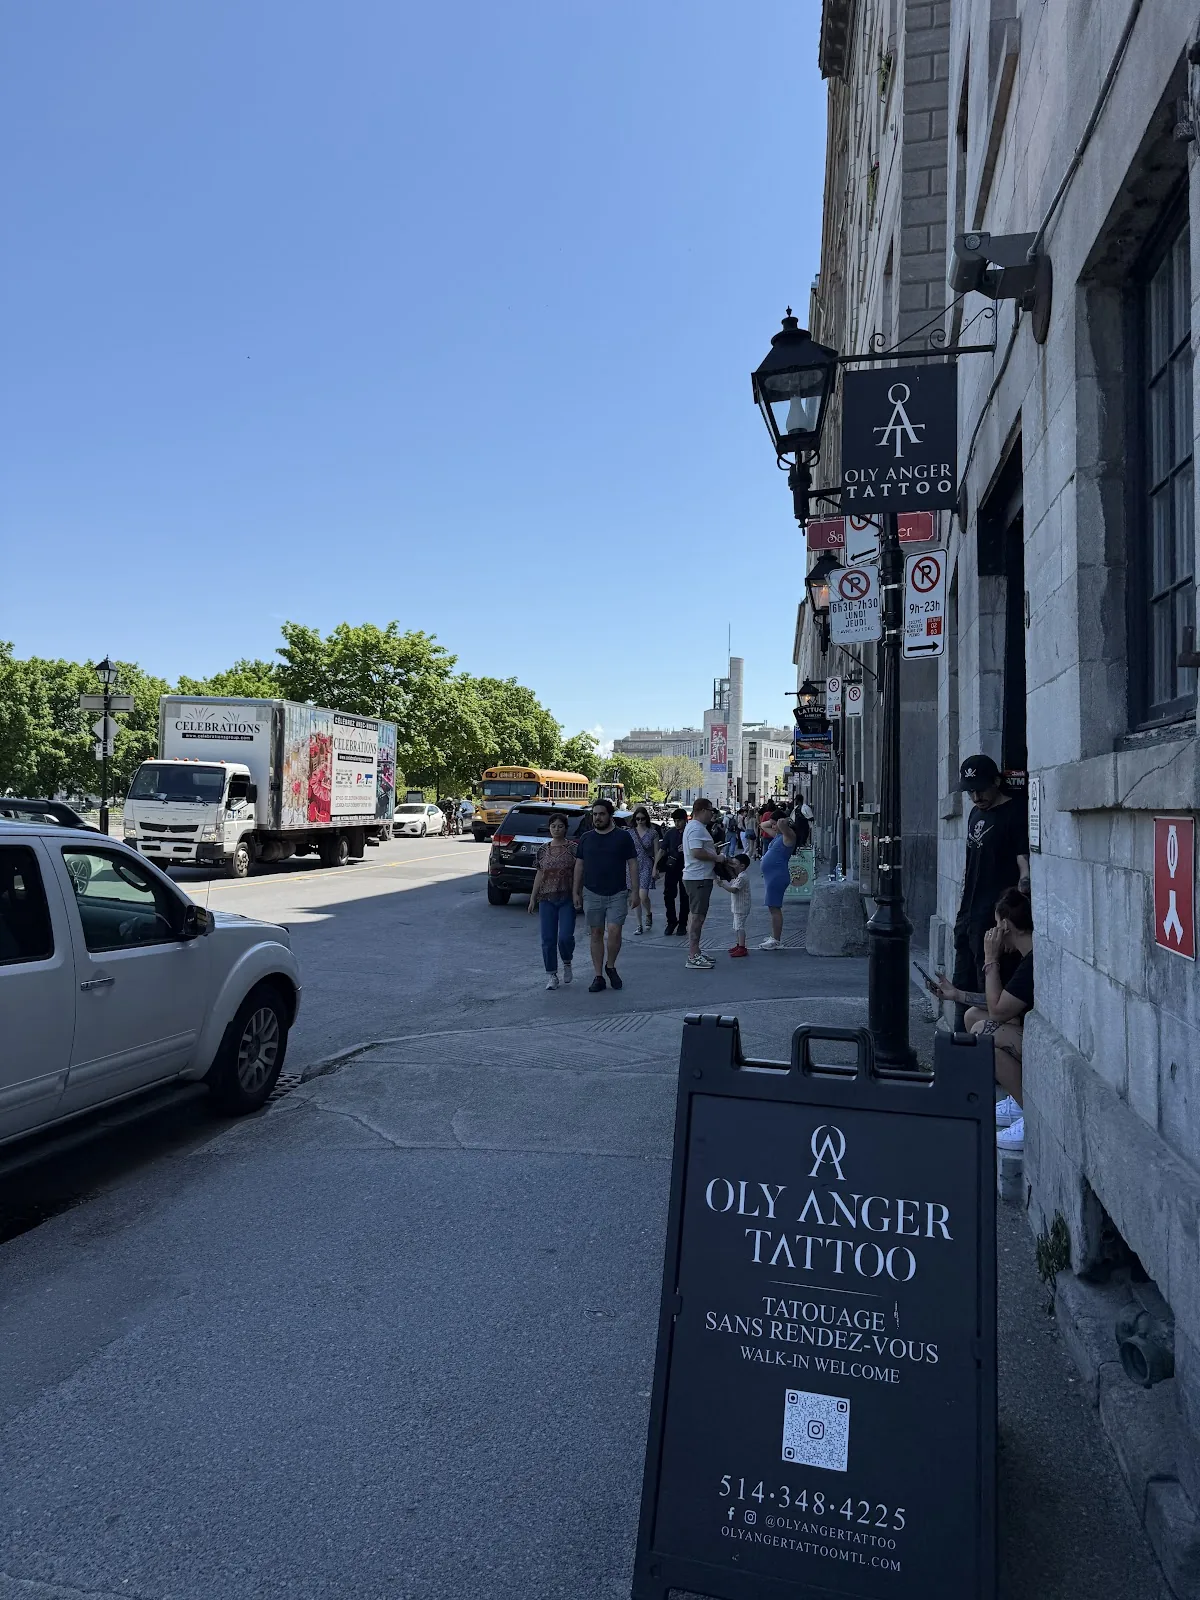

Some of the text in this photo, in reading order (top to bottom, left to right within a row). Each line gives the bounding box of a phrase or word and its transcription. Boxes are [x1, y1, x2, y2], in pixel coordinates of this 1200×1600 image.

[844, 463, 952, 483] OLY ANGER
[846, 479, 952, 499] TATTOO
[832, 597, 878, 614] 6h30-7h30
[845, 610, 866, 620] LUNDI
[909, 601, 941, 615] 9h-23h
[845, 618, 867, 628] JEUDI
[175, 720, 261, 733] CELEBRATIONS
[334, 737, 377, 755] CELEBRATIONS
[1005, 777, 1025, 786] ATM
[705, 1177, 953, 1241] OLY ANGER
[744, 1228, 917, 1282] TATTOO
[762, 1296, 886, 1332] TATOUAGE
[705, 1311, 940, 1364] SANS RENDEZ-VOUS
[740, 1345, 901, 1384] WALK-IN WELCOME
[765, 1514, 896, 1550] @OLYANGERTATTOO
[721, 1525, 902, 1572] OLYANGERTATTOOMTL.COM
